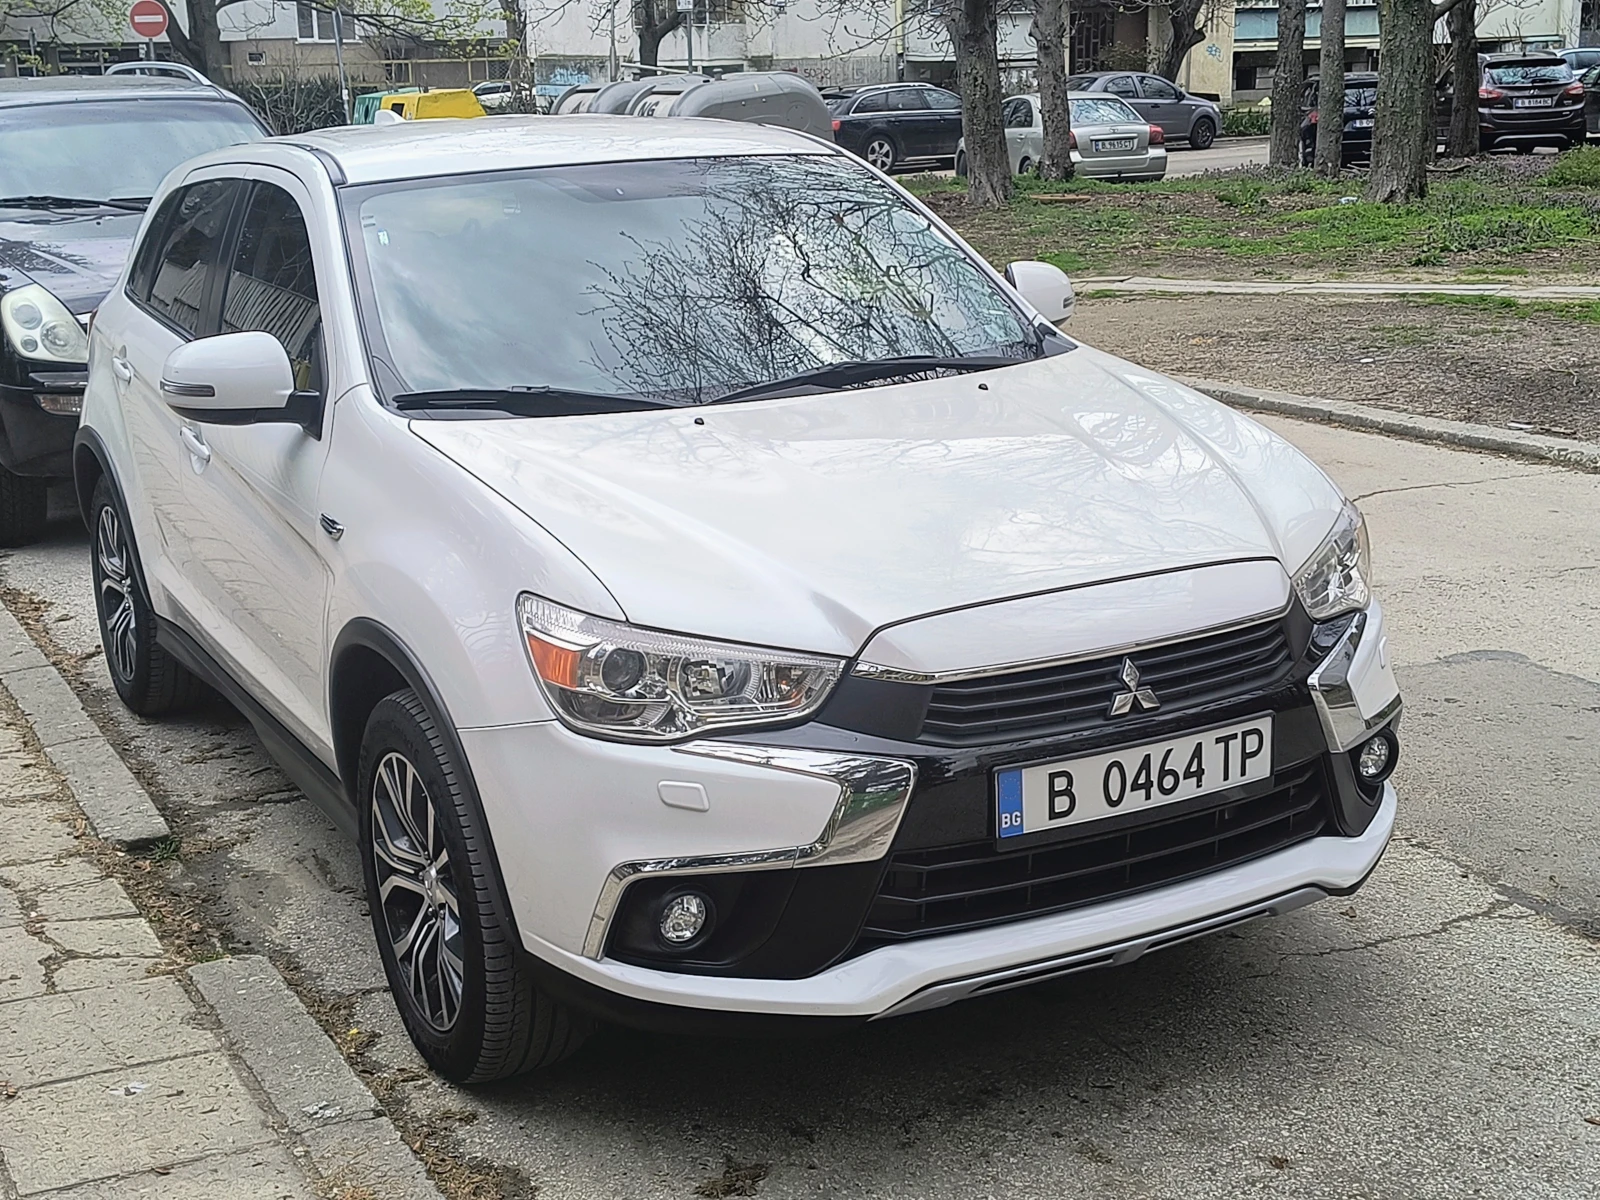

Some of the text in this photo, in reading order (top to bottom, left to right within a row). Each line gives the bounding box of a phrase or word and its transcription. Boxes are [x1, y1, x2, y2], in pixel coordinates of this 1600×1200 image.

[1001, 727, 1264, 829] BG B 0464 TP
